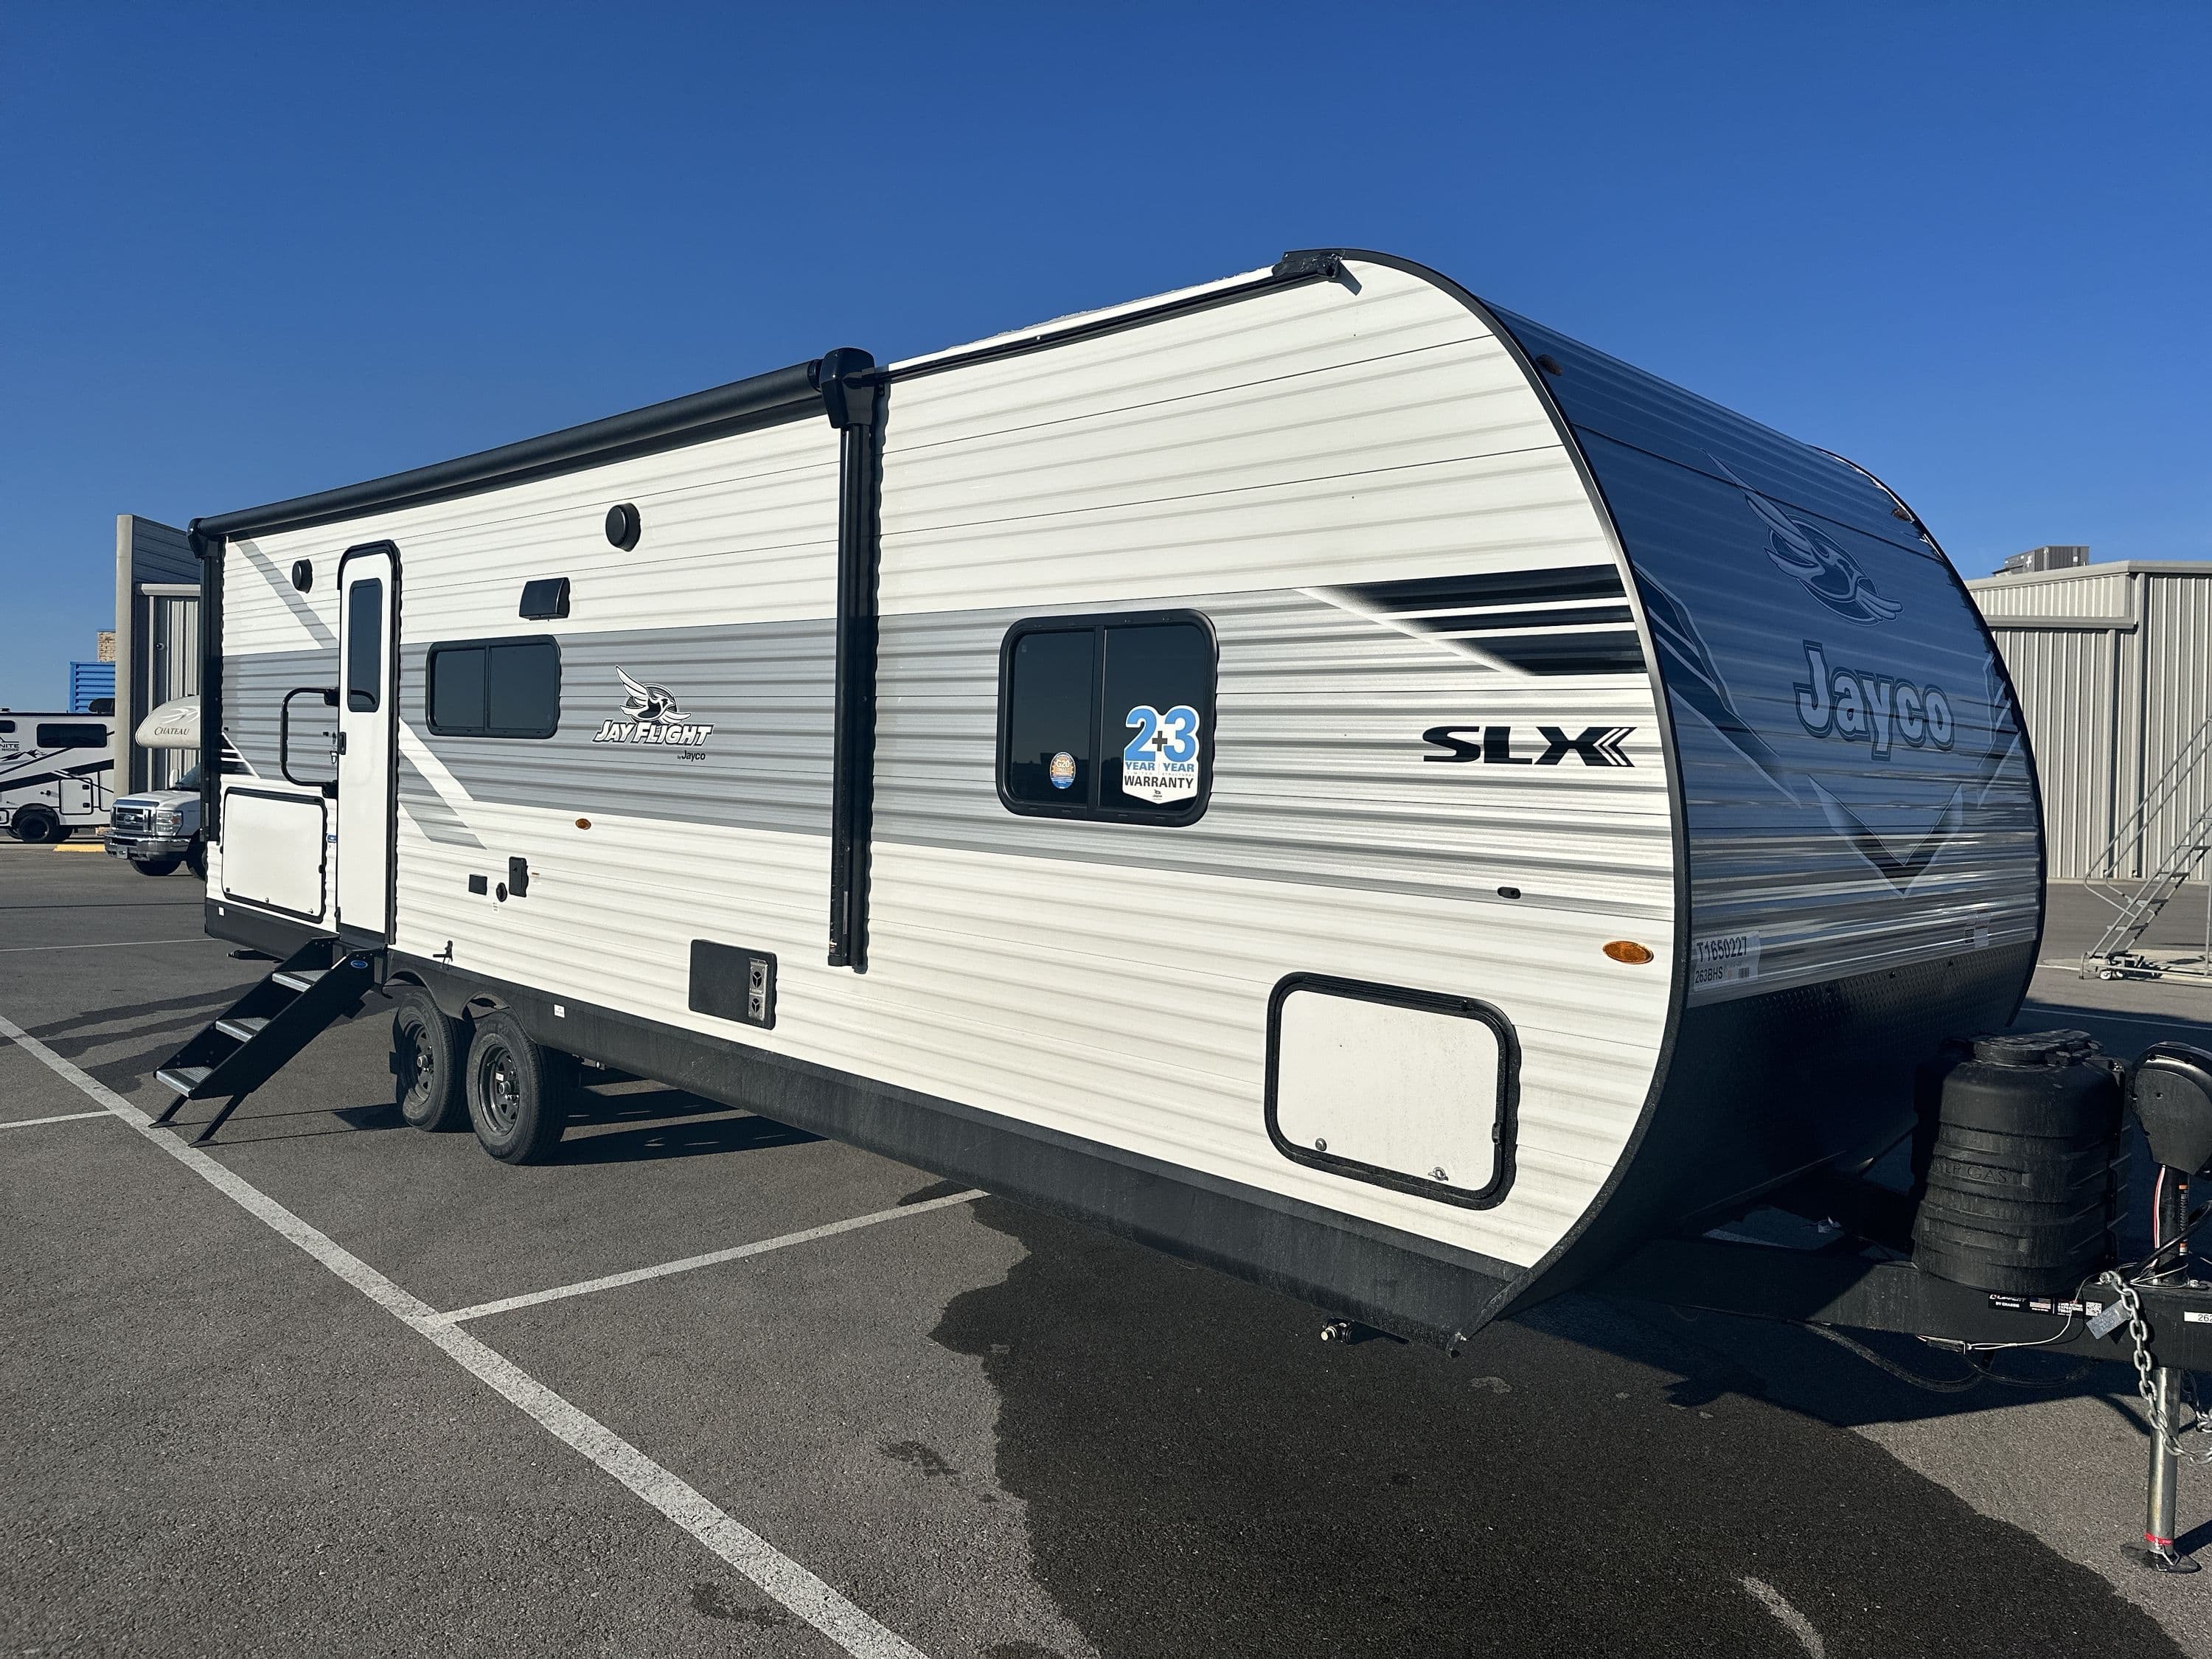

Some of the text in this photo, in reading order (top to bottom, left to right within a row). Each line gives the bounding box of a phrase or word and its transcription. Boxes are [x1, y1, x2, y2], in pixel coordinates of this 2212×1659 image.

[1793, 639, 1954, 762] Jayco
[154, 726, 190, 736] CHATEAU
[593, 720, 714, 745] JAY FLIGHT
[1422, 726, 1638, 767] SLX
[681, 750, 706, 762] Jayco
[1056, 759, 1070, 768] G20
[1125, 762, 1194, 772] YEAR YEAR
[1124, 776, 1194, 788] WARRANTY
[1697, 936, 1747, 962] T1650227
[1695, 966, 1723, 984] 263BHS
[1967, 1166, 2007, 1183] GAS
